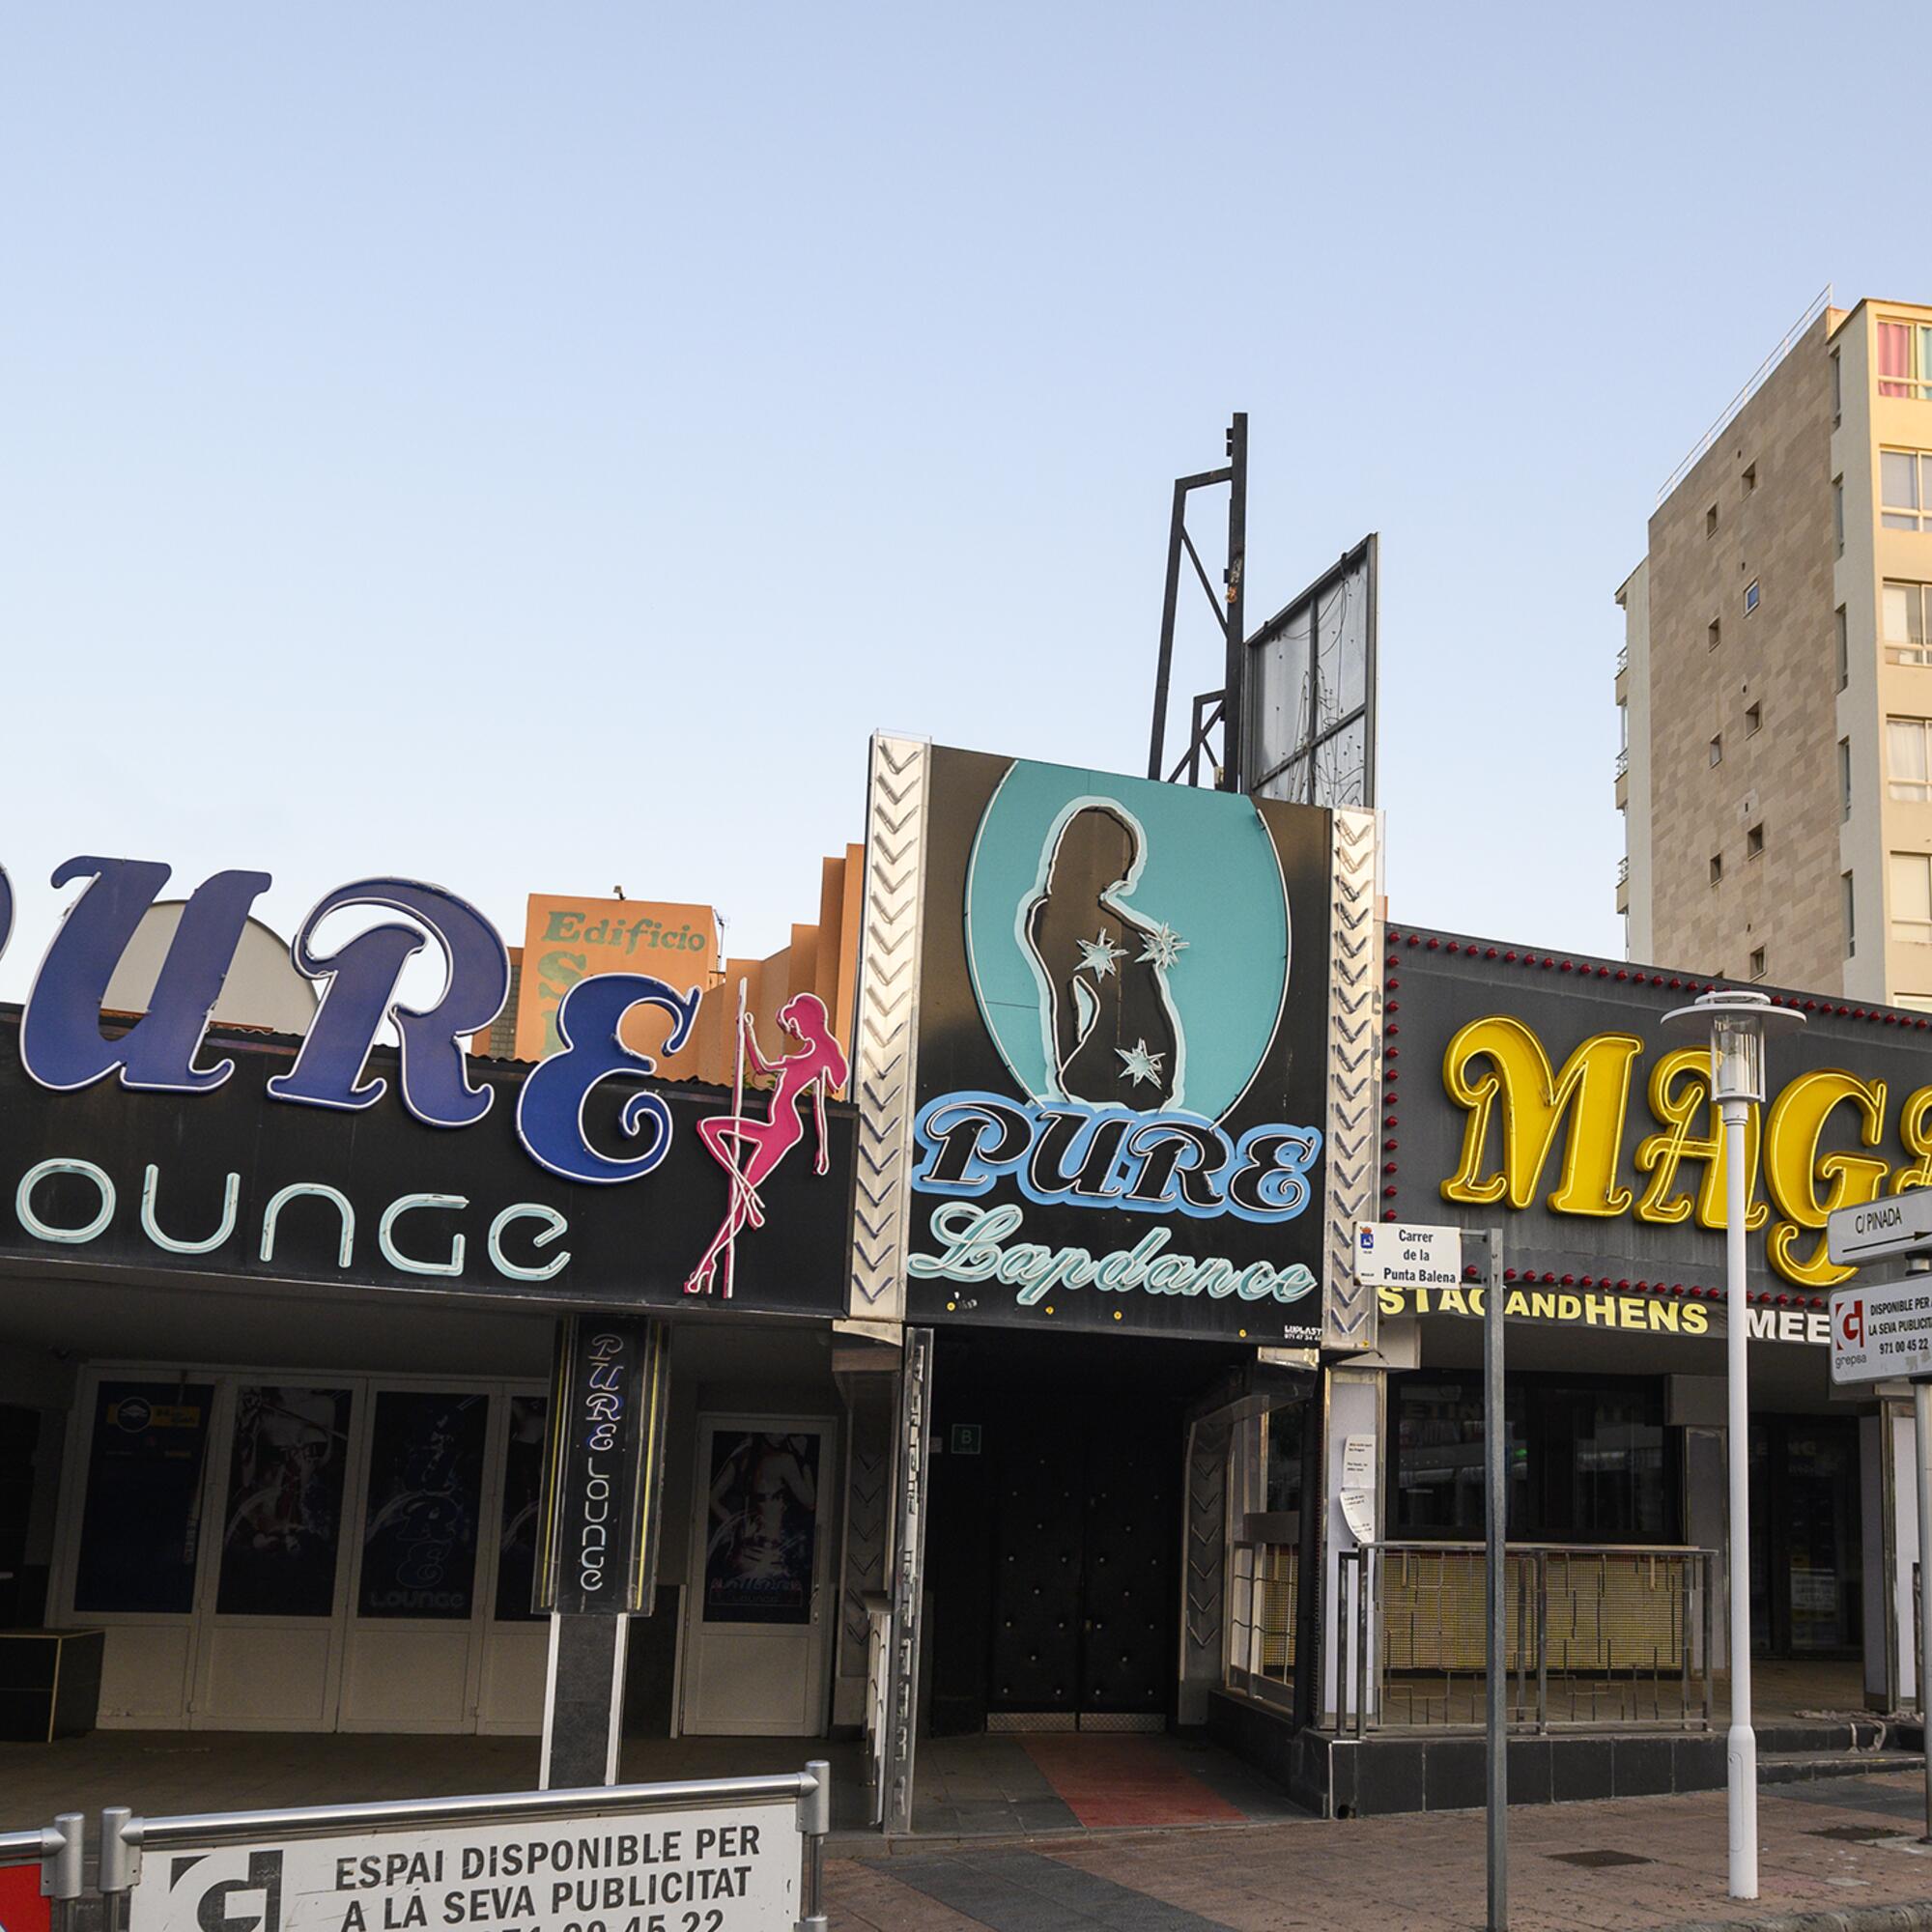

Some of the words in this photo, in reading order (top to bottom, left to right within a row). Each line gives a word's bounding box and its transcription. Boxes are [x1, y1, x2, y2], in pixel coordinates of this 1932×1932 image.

[540, 910, 706, 955] Edificio
[0, 855, 703, 1185] URE
[914, 1095, 1321, 1219] PURE
[1440, 1012, 1932, 1288] MAG
[1399, 1229, 1435, 1243] Carrer
[1866, 1207, 1903, 1233] PINADA
[908, 1201, 1319, 1306] Lapdance
[1403, 1249, 1417, 1261] de
[1420, 1249, 1430, 1262] la
[1383, 1267, 1415, 1282] Punta
[1419, 1269, 1456, 1284] Balena
[1583, 1294, 1709, 1335] HENS
[1868, 1324, 1878, 1337] LA
[1879, 1321, 1897, 1335] SEVA
[1898, 1317, 1932, 1333] PUBLICIT
[1870, 1299, 1914, 1317] DISPONIBLE
[1915, 1296, 1930, 1310] PER
[1834, 1352, 1867, 1370] grepsa
[1879, 1342, 1893, 1354] 971
[1895, 1341, 1905, 1353] 00
[1907, 1339, 1917, 1351] 45
[1918, 1338, 1929, 1350] 22
[585, 1333, 624, 1451] PURE
[336, 1849, 444, 1891] ESPAI
[461, 1830, 682, 1881] DISPONIBLE
[696, 1825, 761, 1861] PER
[340, 1899, 367, 1932] A
[442, 1884, 536, 1925] SEVA
[551, 1865, 753, 1915] PUBLICITAT
